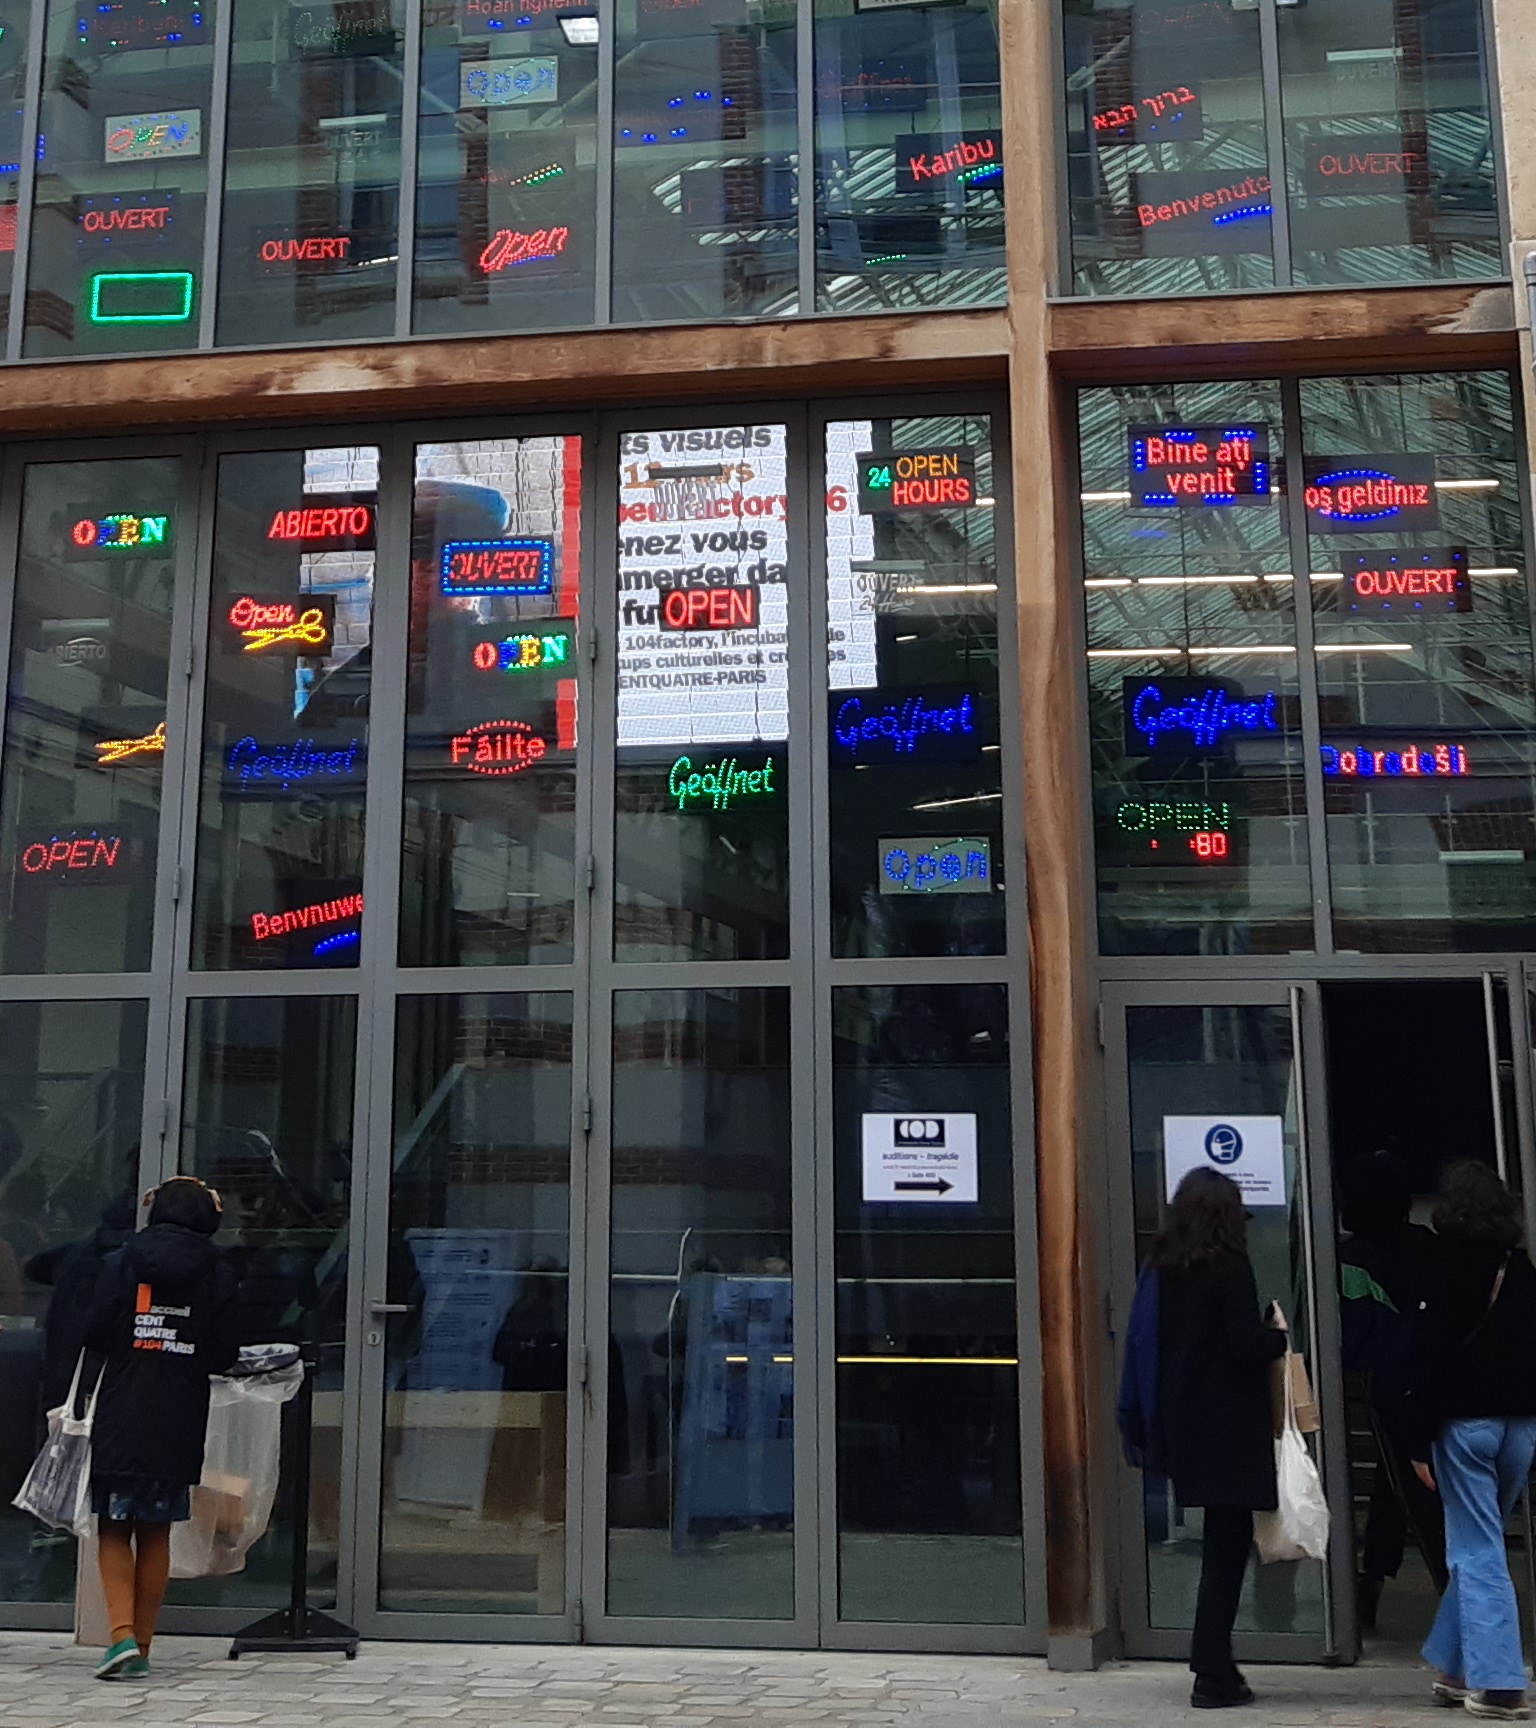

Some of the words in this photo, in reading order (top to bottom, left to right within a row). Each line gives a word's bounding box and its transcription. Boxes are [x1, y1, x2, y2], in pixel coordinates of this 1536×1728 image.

[107, 121, 189, 152] OPEN
[910, 138, 995, 181] Karibu
[1319, 152, 1416, 174] OUVERT
[83, 206, 169, 232] OUVERT
[261, 236, 350, 261] OUVERT
[478, 226, 568, 272] Open
[659, 426, 771, 453] visuels
[1146, 437, 1207, 464] Bine
[897, 454, 957, 478] OPEN
[1166, 468, 1235, 493] venit
[867, 466, 891, 488] 24
[893, 478, 969, 506] HOURS
[72, 516, 167, 546] OPEN
[269, 505, 367, 538] ABIERTO
[690, 529, 767, 553] vous
[1355, 568, 1457, 595] OUVERT
[229, 596, 294, 627] Open
[664, 588, 753, 627] OPEN
[473, 634, 569, 669] OPEN
[655, 651, 742, 669] culturelles
[619, 669, 766, 689] ENTQUATRE-PARIS
[1116, 801, 1231, 831] OPEN
[22, 836, 120, 872] OPEN
[884, 848, 987, 886] Open
